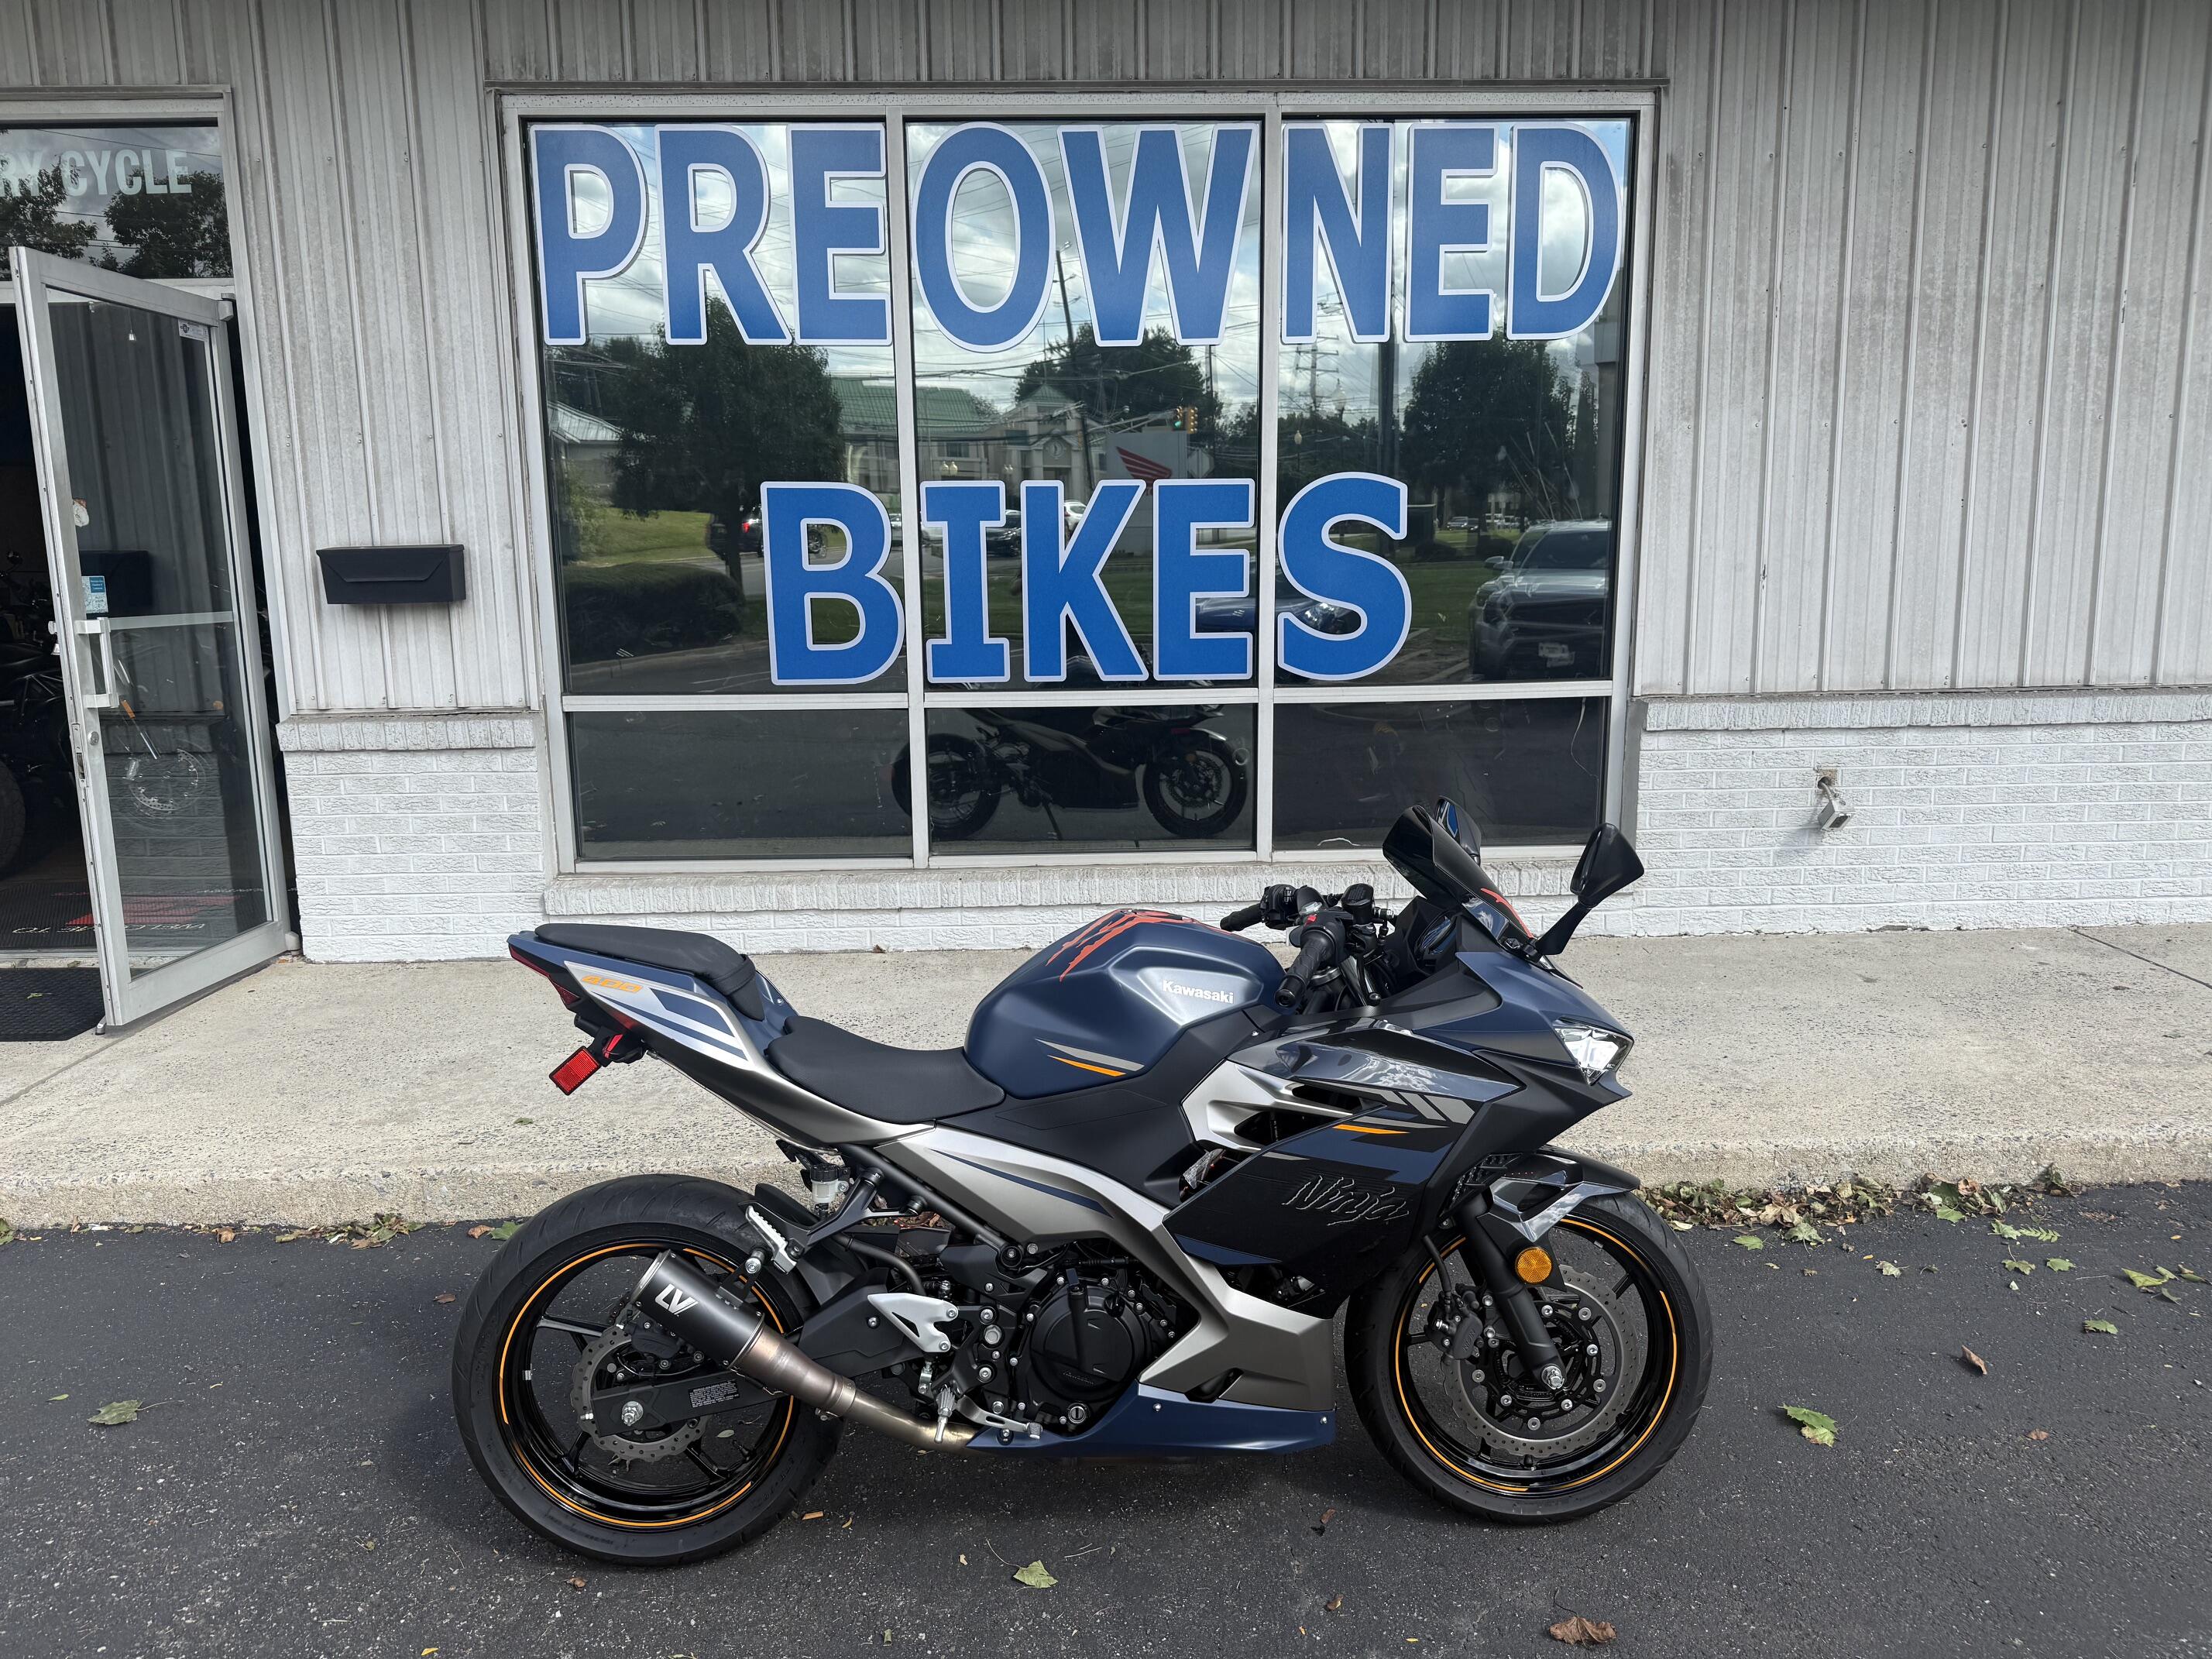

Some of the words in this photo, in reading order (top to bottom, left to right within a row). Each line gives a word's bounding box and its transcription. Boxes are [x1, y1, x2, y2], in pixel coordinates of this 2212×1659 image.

[60, 149, 193, 196] CYCLE
[530, 121, 1622, 353] PREOWNED
[761, 472, 1412, 685] BIKES
[582, 975, 644, 993] 400
[1163, 979, 1234, 1005] Kawasaki
[1281, 1175, 1410, 1226] Ninja
[655, 1283, 699, 1315] LV
